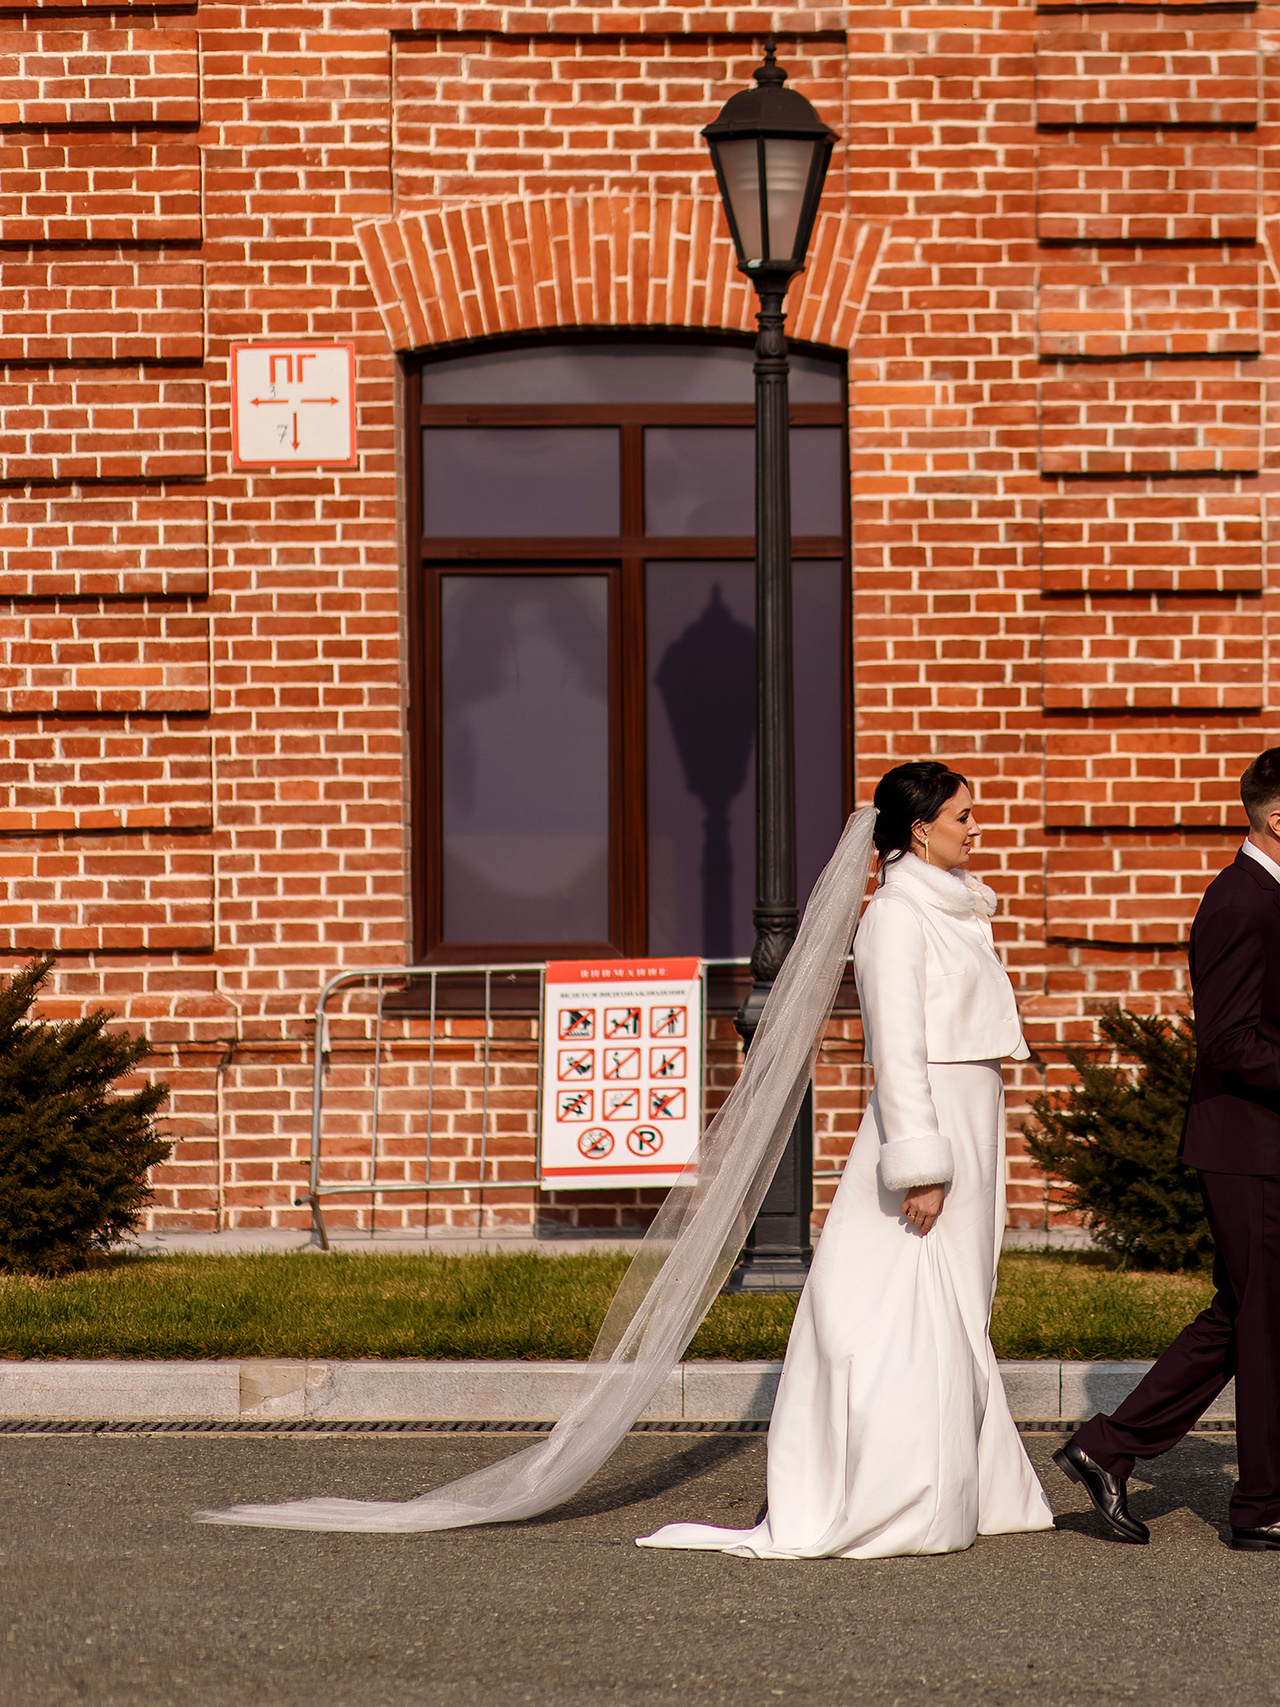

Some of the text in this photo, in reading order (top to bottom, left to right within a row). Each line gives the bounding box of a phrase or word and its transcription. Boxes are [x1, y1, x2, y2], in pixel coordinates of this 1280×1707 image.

[269, 354, 316, 383] ПГ
[276, 425, 288, 444] 7
[580, 968, 667, 978] ВНИМАНИЕ
